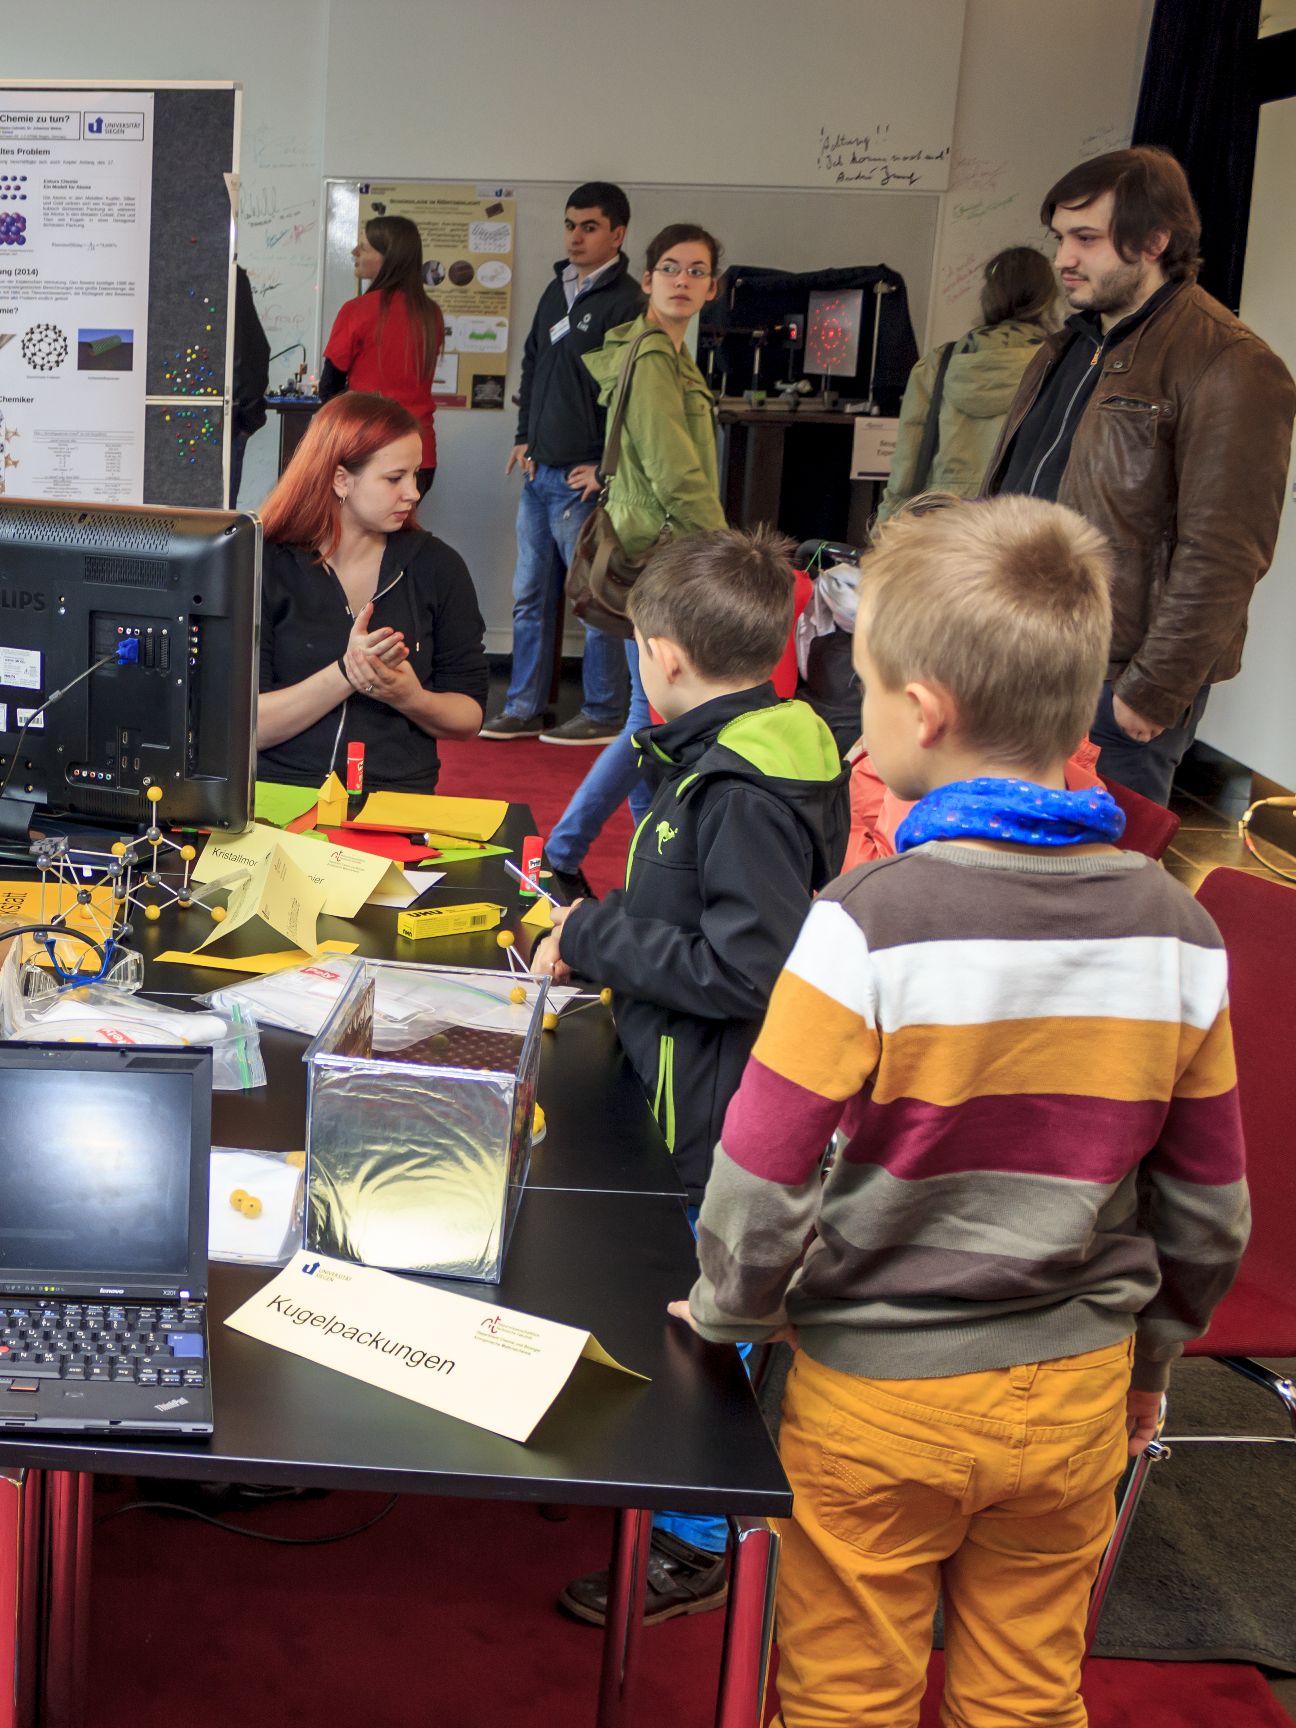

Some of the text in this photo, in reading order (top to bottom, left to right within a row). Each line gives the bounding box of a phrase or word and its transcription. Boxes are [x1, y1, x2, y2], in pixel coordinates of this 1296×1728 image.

[0, 114, 34, 123] Chemie
[49, 114, 70, 123] tun?
[17, 148, 51, 156] Problem
[14, 268, 39, 277] (2014)
[99, 1287, 125, 1295] lenovo
[266, 1293, 456, 1376] Kugelpackungen
